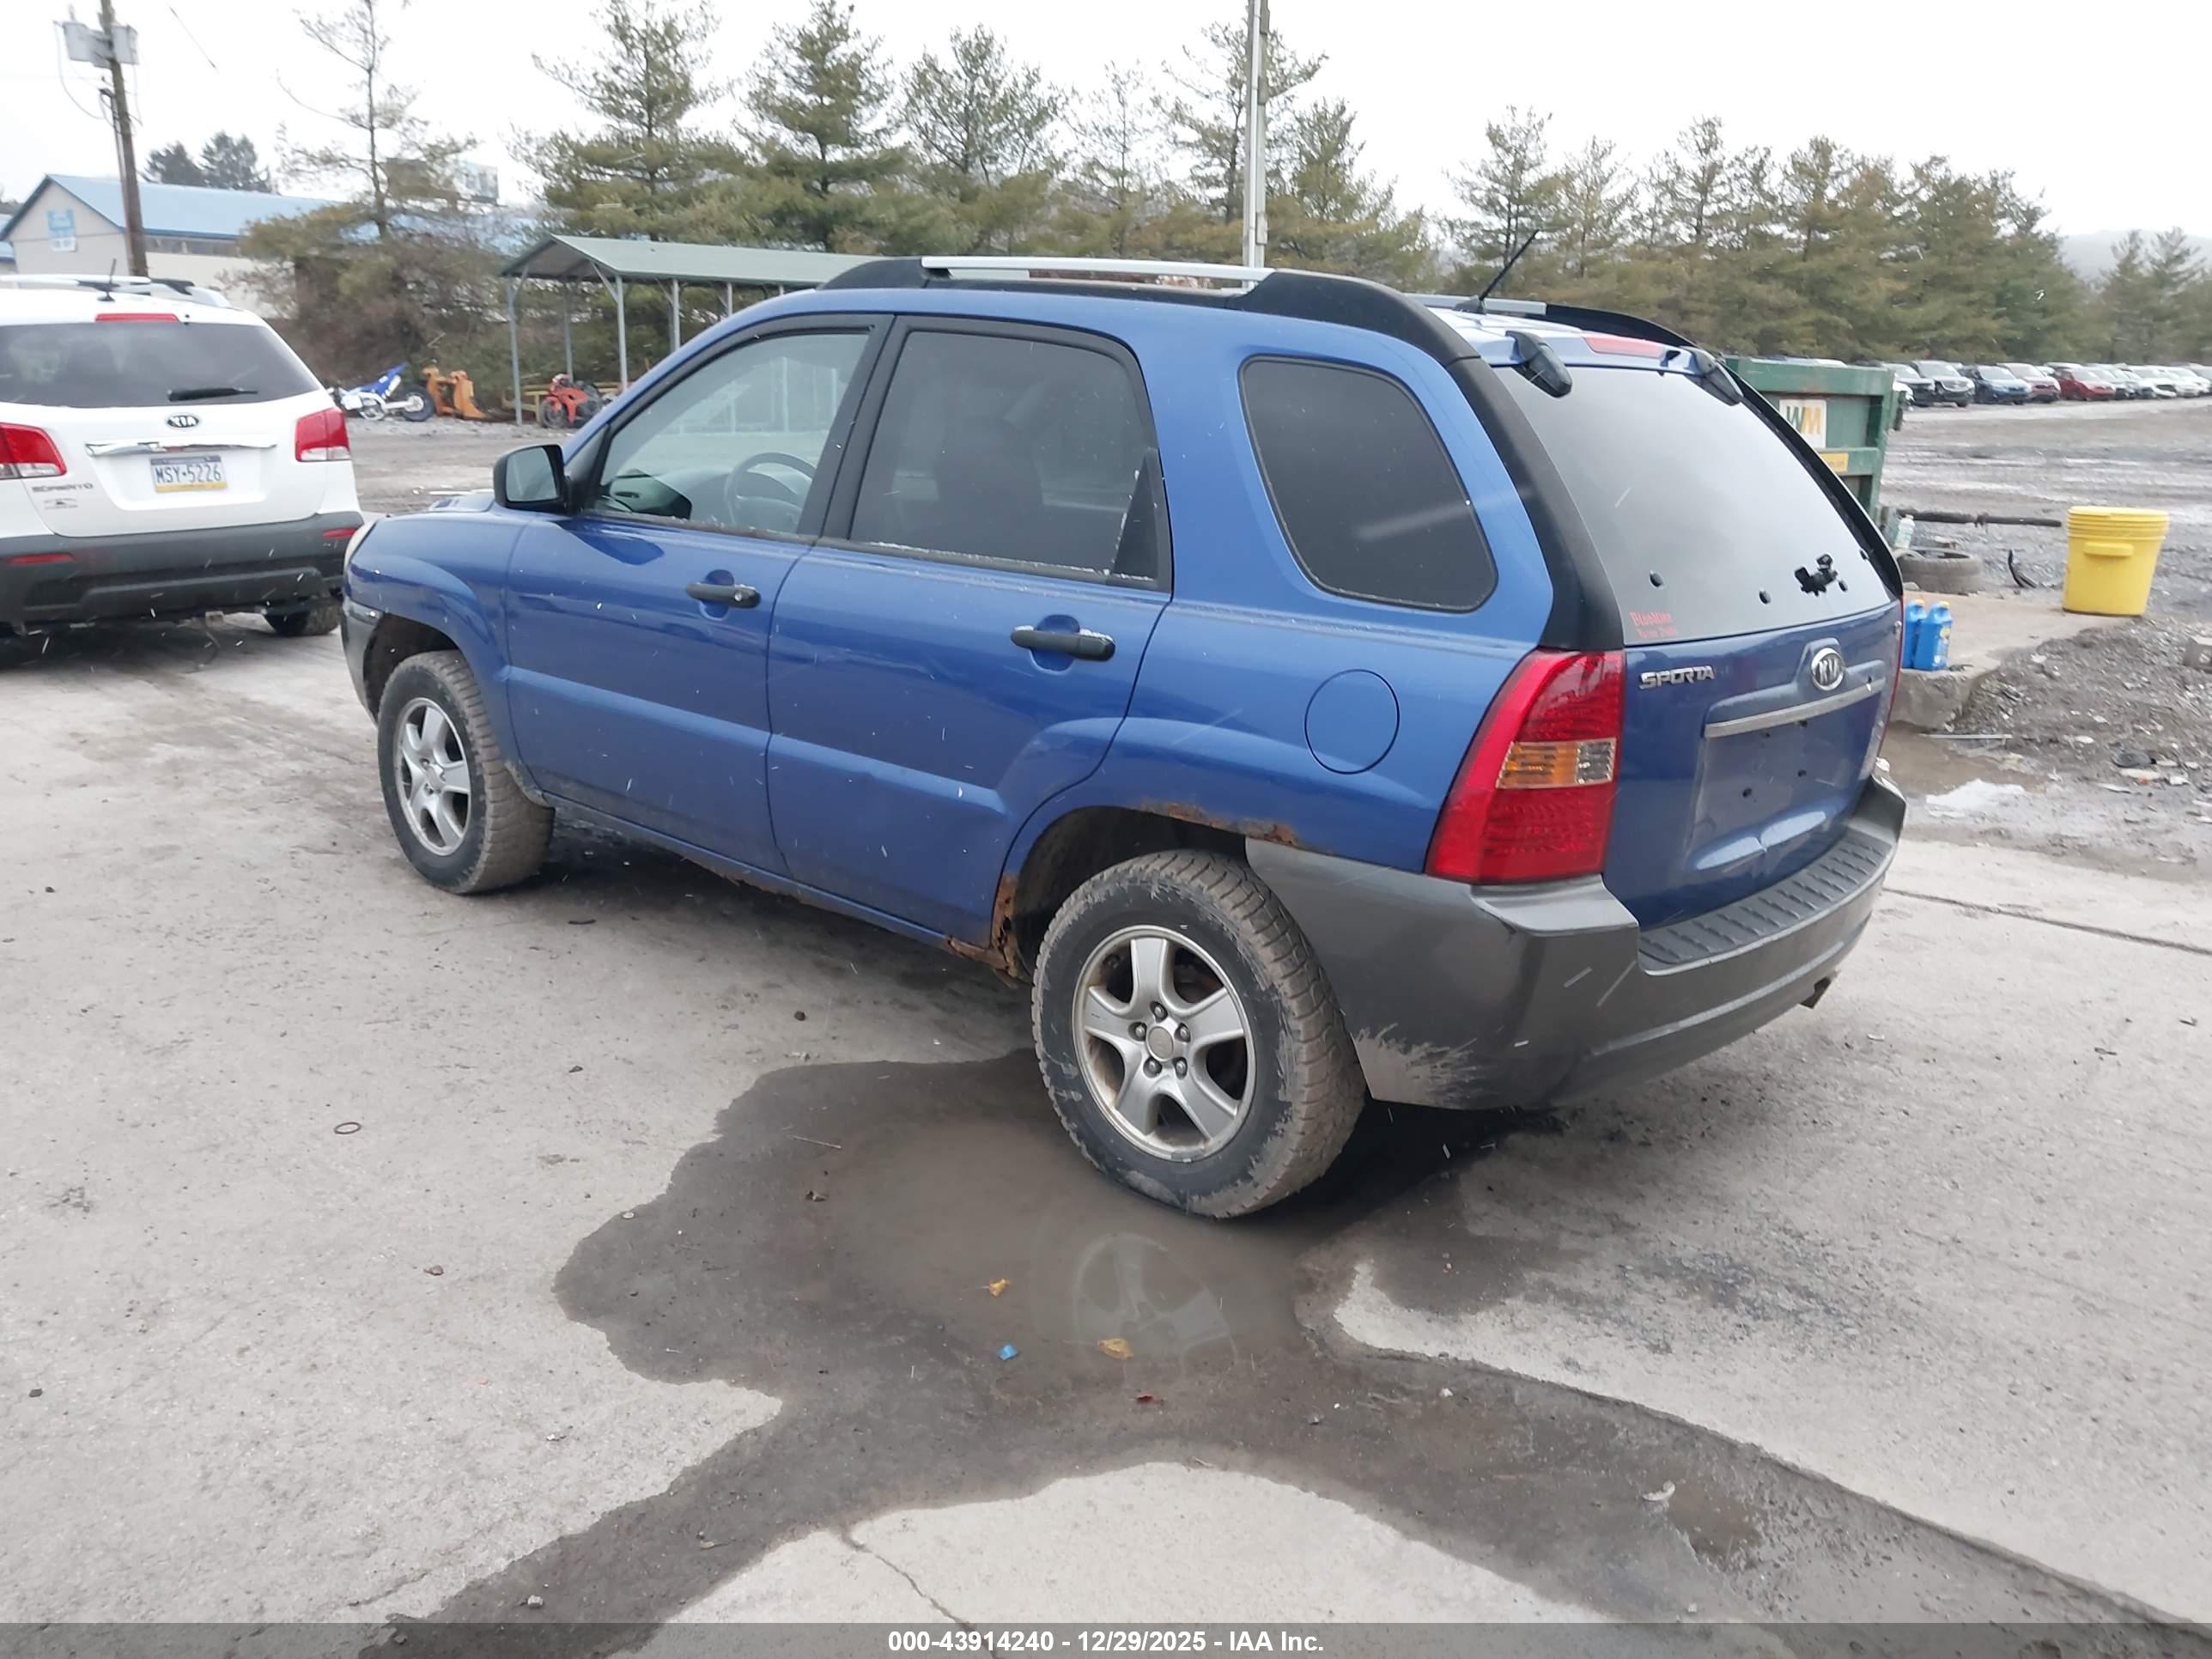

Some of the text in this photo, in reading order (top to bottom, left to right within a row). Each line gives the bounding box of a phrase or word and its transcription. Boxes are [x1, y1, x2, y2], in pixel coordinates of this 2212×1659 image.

[167, 415, 199, 428] KIA
[1787, 406, 1821, 434] WM
[1639, 665, 1715, 690] SPORTA
